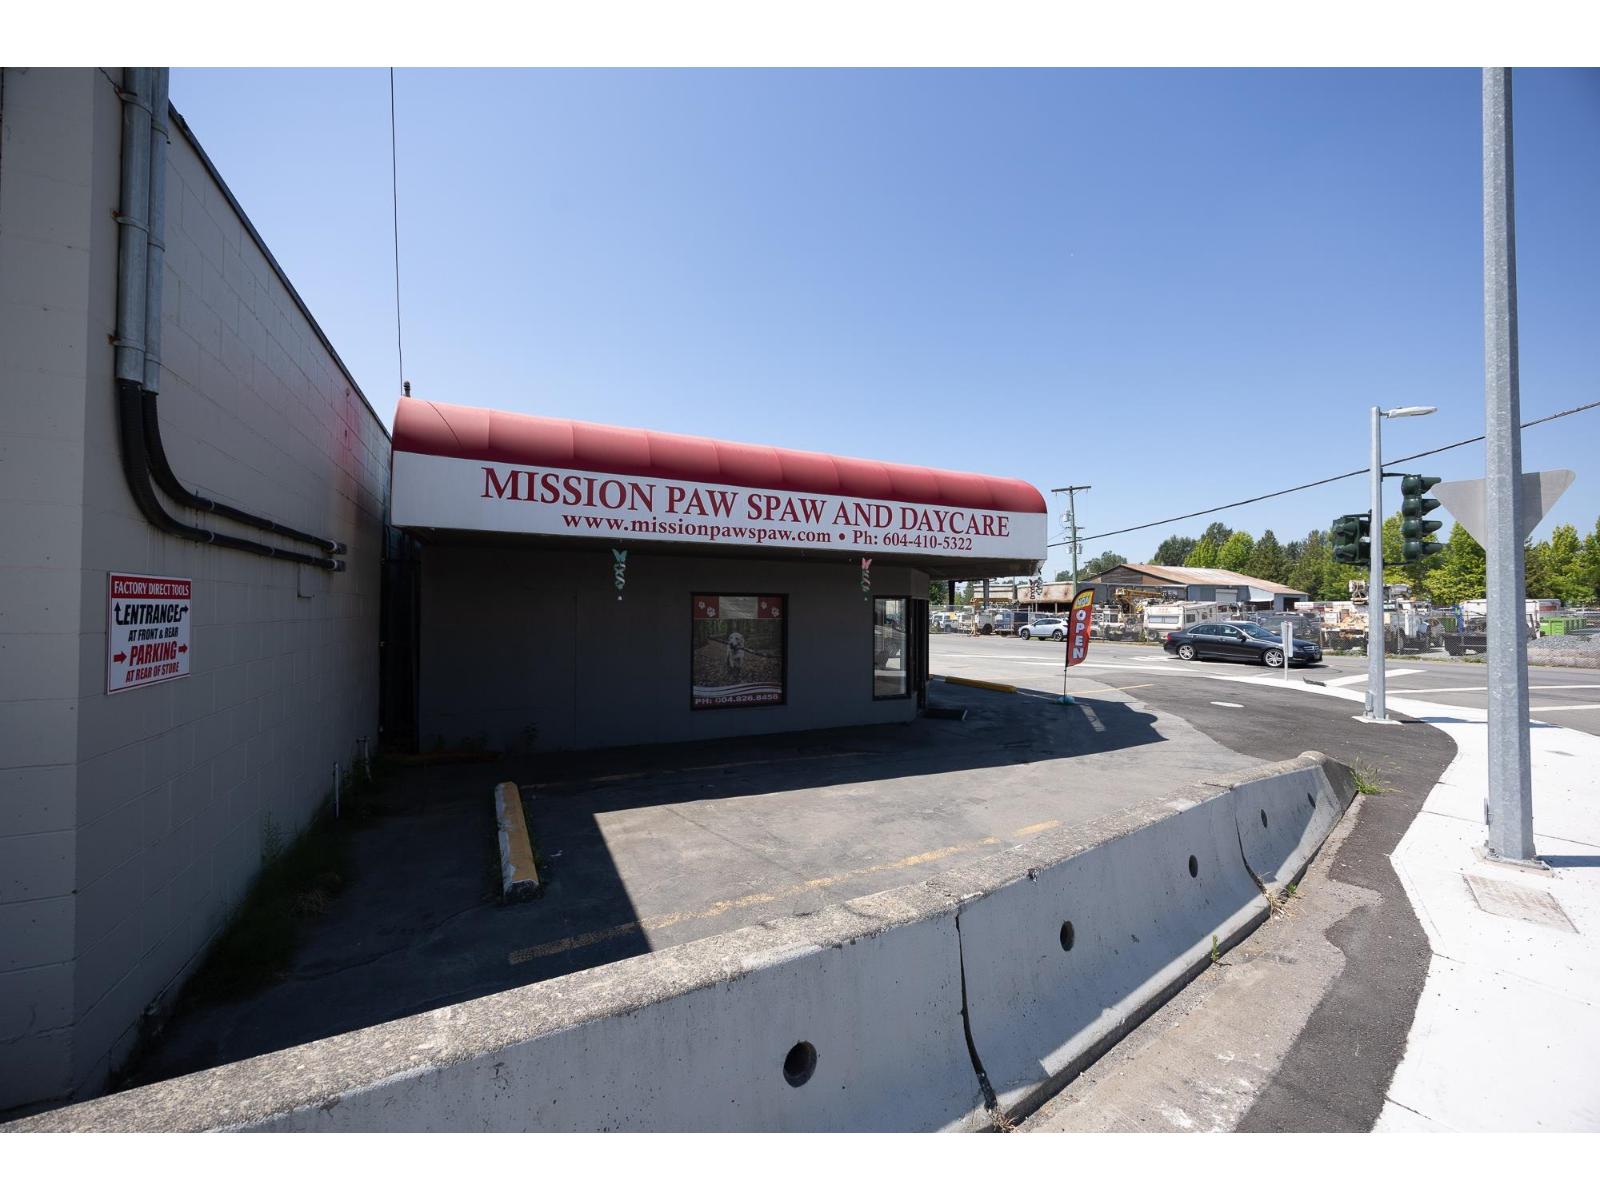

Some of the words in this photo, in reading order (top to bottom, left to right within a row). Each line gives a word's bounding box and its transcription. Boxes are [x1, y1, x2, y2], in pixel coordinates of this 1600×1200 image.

[480, 467, 656, 512] MISSION
[665, 486, 739, 518] PAW
[747, 493, 827, 525] SPAW
[832, 501, 893, 528] AND
[900, 507, 1010, 537] DAYCARE
[562, 514, 832, 543] www.missionpawspaw.com
[852, 530, 878, 546] Ph:
[883, 532, 973, 551] 604-410-5322
[114, 581, 147, 595] FACTORY
[148, 583, 170, 595] DIRECT
[171, 584, 189, 596] TOOLS
[124, 604, 180, 625] ENTRANCE
[128, 629, 138, 642] AT
[138, 628, 158, 641] FRONT
[164, 627, 179, 638] REAR
[1072, 609, 1087, 659] OPEN
[129, 640, 178, 666] PARKING
[126, 670, 136, 682] AT
[136, 667, 153, 680] REAR
[153, 665, 161, 677] OF
[160, 662, 179, 676] STORE
